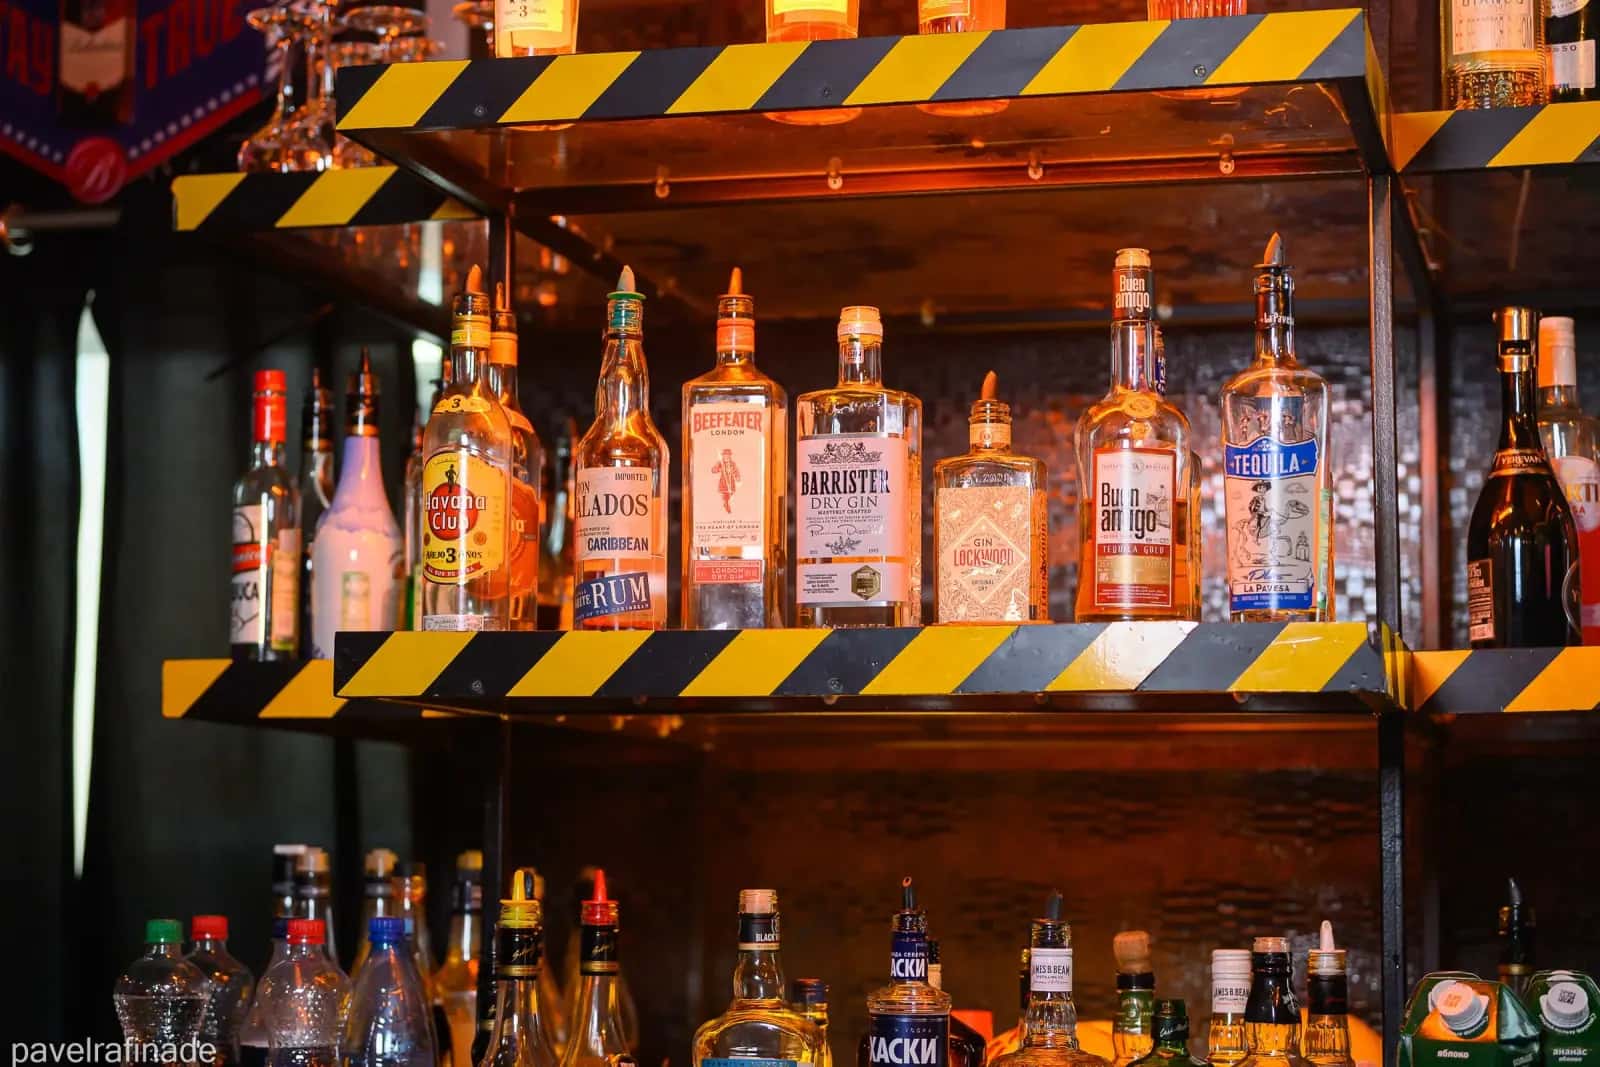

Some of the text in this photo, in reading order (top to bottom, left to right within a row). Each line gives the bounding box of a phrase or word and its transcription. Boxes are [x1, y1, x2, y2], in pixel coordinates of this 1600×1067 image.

[1119, 274, 1146, 292] Buen
[1115, 291, 1150, 313] amigo
[452, 398, 461, 409] 3
[693, 411, 762, 433] BEEFEATER
[1233, 452, 1301, 476] TEQUILA
[614, 472, 648, 481] IMPORTED
[800, 468, 890, 496] BARRISTER
[425, 491, 487, 511] Havana
[811, 495, 878, 510] DRY GIN
[432, 511, 470, 530] Club
[1101, 508, 1156, 540] amigo
[587, 535, 649, 552] CARIBBEAN
[973, 537, 993, 547] GIN
[446, 547, 456, 564] 3
[953, 548, 1014, 567] LOCKWOOD
[590, 575, 648, 609] RUM
[890, 958, 926, 977] АСКИ
[869, 1035, 937, 1065] ХАСКИ
[1437, 1048, 1470, 1059] яблоко
